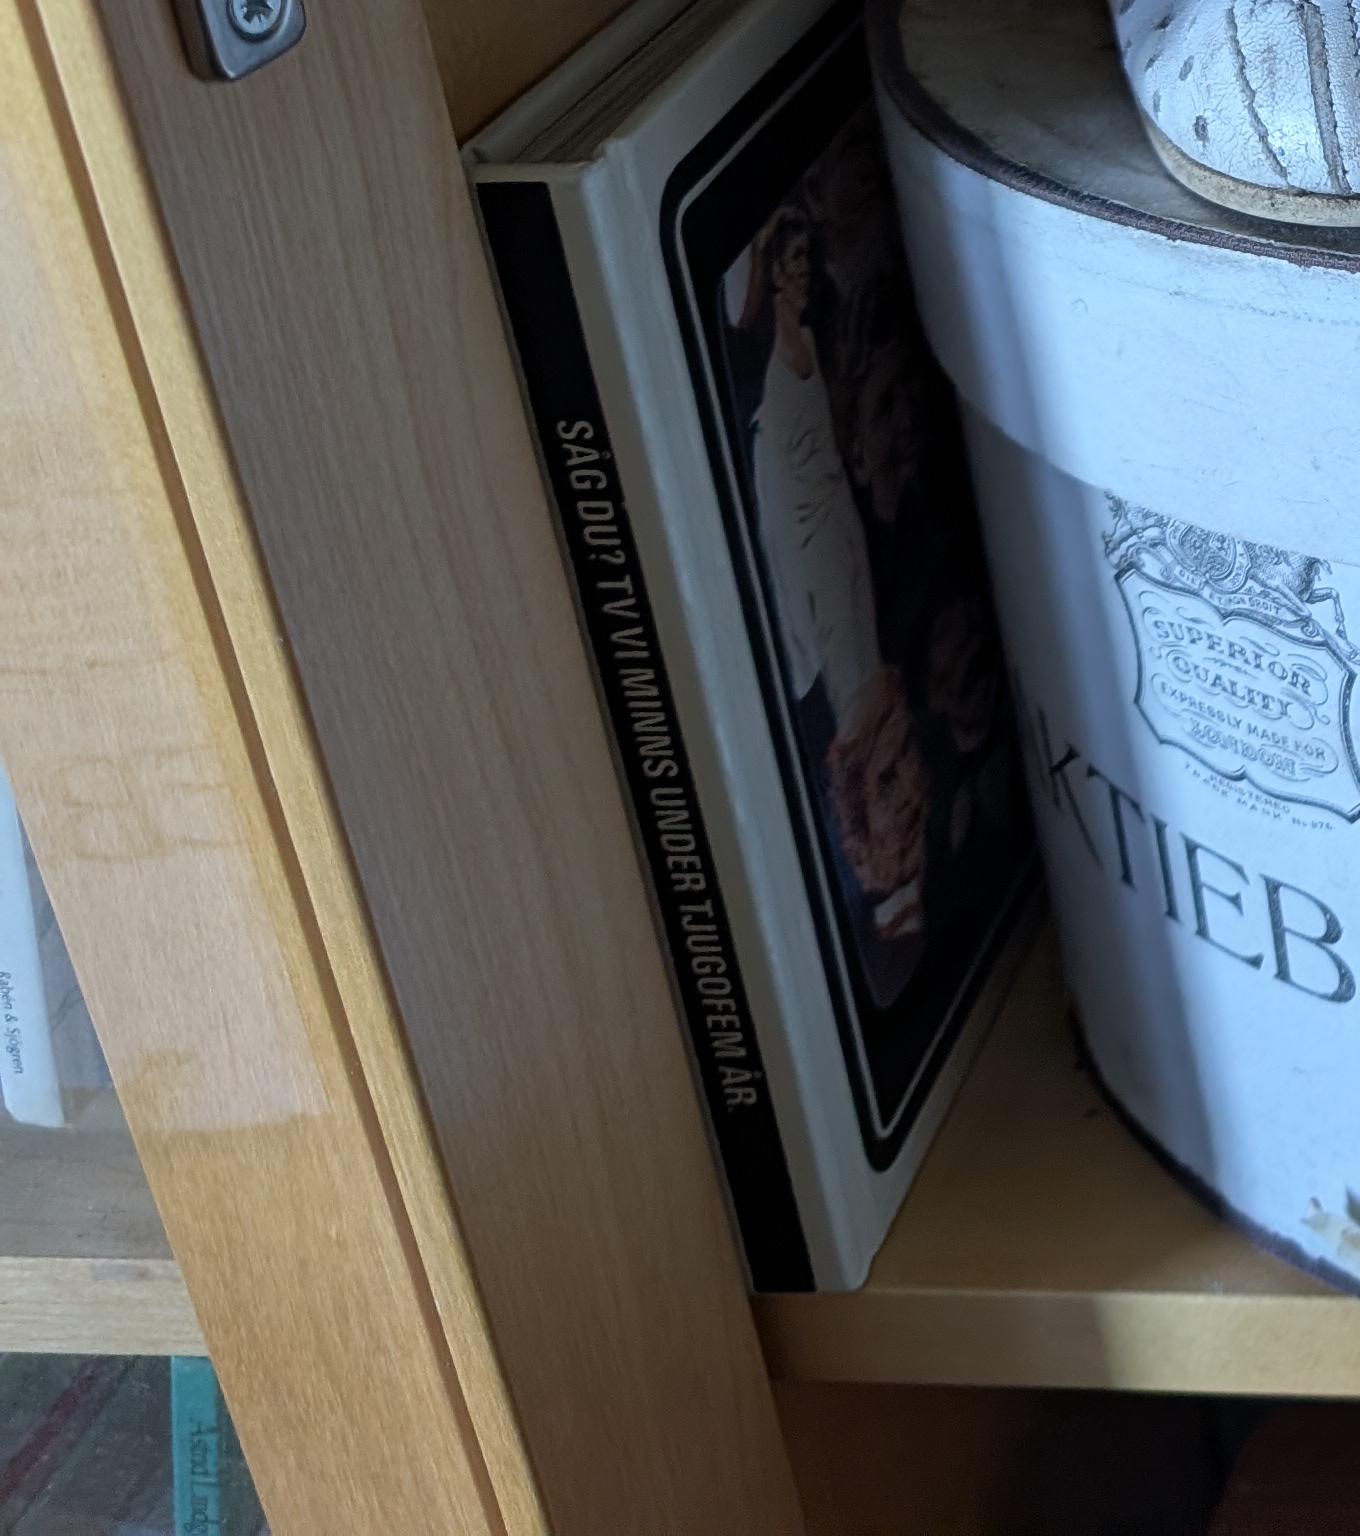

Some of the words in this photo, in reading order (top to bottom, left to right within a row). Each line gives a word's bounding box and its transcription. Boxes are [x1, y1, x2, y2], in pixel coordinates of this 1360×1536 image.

[557, 420, 611, 490] SÅG
[577, 500, 626, 565] DU?
[597, 574, 640, 619] TV
[610, 626, 650, 658] VI
[1154, 619, 1312, 697] SUPERIOR
[618, 668, 679, 779] MINNS
[1161, 681, 1243, 731] EXPRESSLY
[1248, 716, 1290, 748] MADE
[1295, 738, 1327, 761] FOR
[1175, 656, 1294, 718] QUALITY
[651, 787, 706, 892] UNDER
[679, 898, 748, 1059] TJUGOFEM
